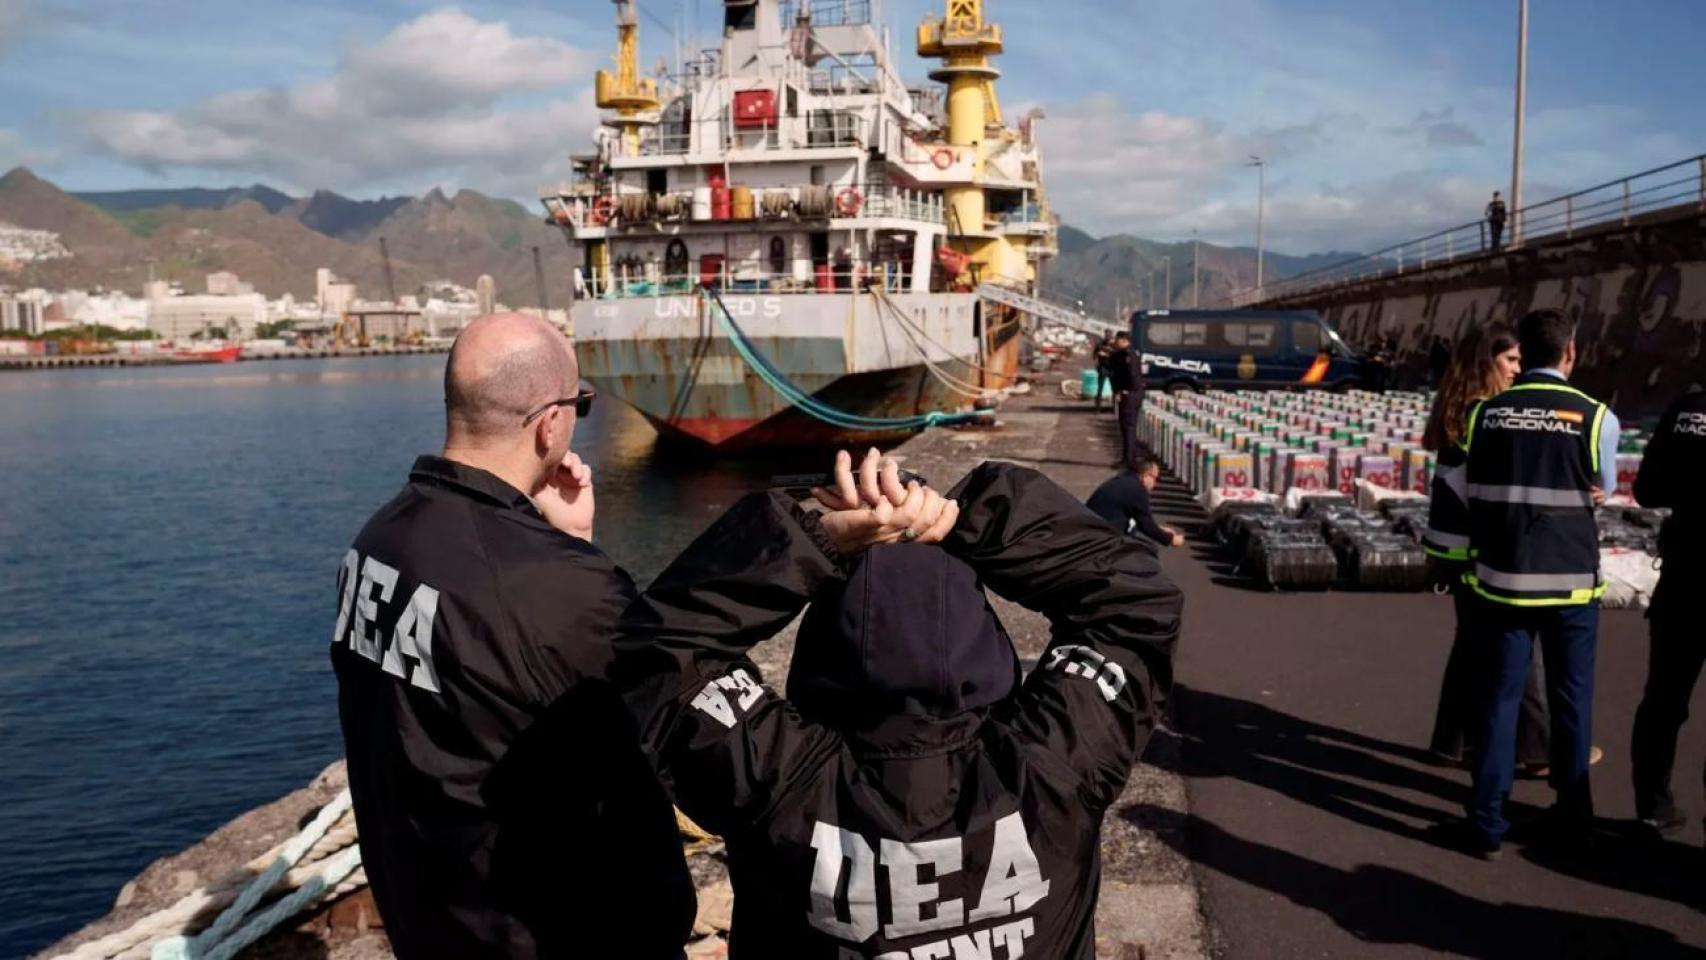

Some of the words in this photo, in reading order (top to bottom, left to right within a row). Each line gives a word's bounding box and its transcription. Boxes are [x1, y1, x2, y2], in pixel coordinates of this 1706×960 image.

[763, 297, 782, 317] S
[1485, 407, 1557, 419] POLICIA
[1676, 411, 1706, 424] PO
[1482, 418, 1581, 435] NACIONAL
[806, 811, 1050, 943] DEA
